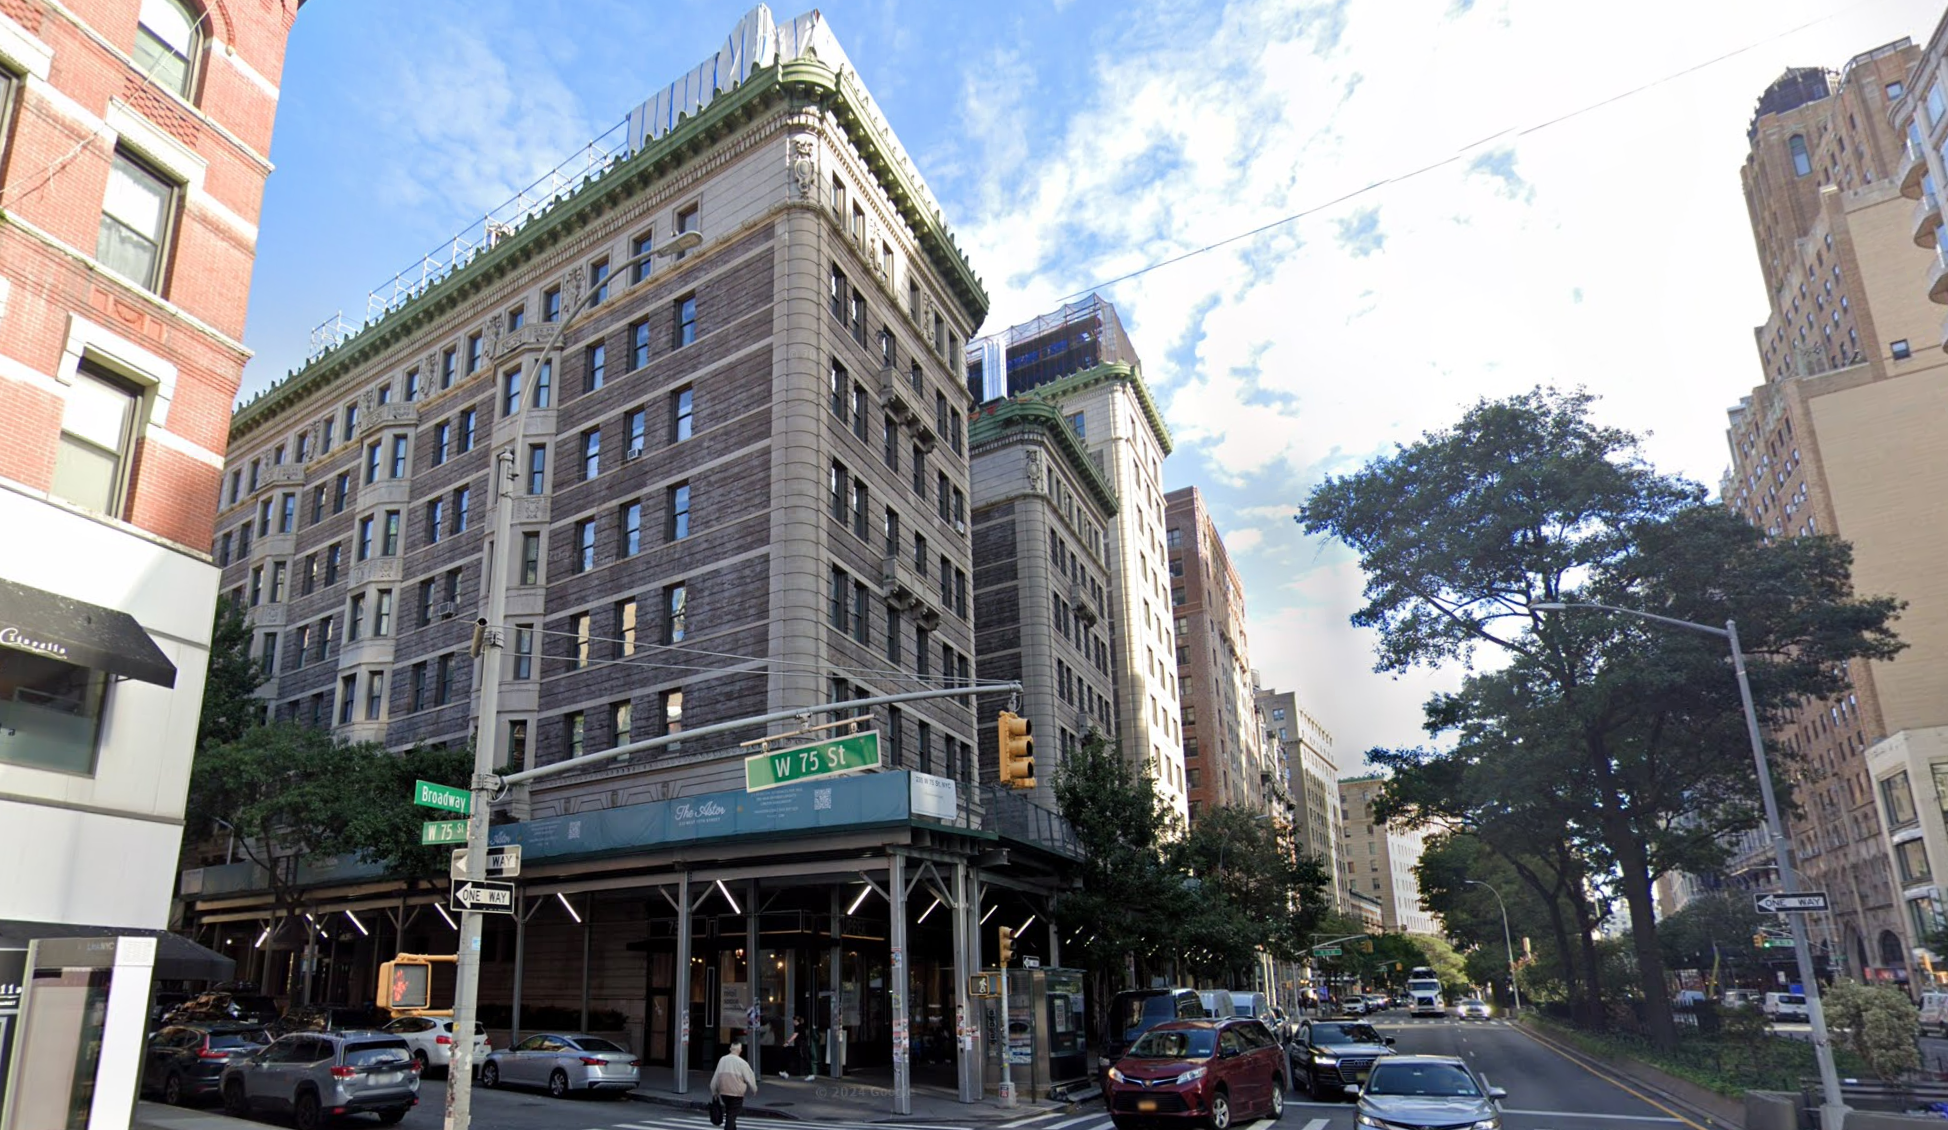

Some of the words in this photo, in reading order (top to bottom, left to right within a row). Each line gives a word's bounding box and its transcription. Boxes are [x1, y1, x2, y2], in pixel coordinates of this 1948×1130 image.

[775, 757, 791, 778] W
[800, 753, 819, 772] 75
[828, 745, 846, 767] St
[422, 786, 466, 812] Broadway
[675, 803, 694, 820] The
[695, 801, 726, 818] Astor
[428, 826, 437, 841] W
[441, 824, 453, 840] 75
[457, 823, 464, 834] St
[492, 855, 513, 867] WAY
[462, 889, 481, 902] ONE
[489, 892, 507, 904] WAY
[1765, 899, 1787, 908] ONE
[1798, 898, 1820, 906] WAY
